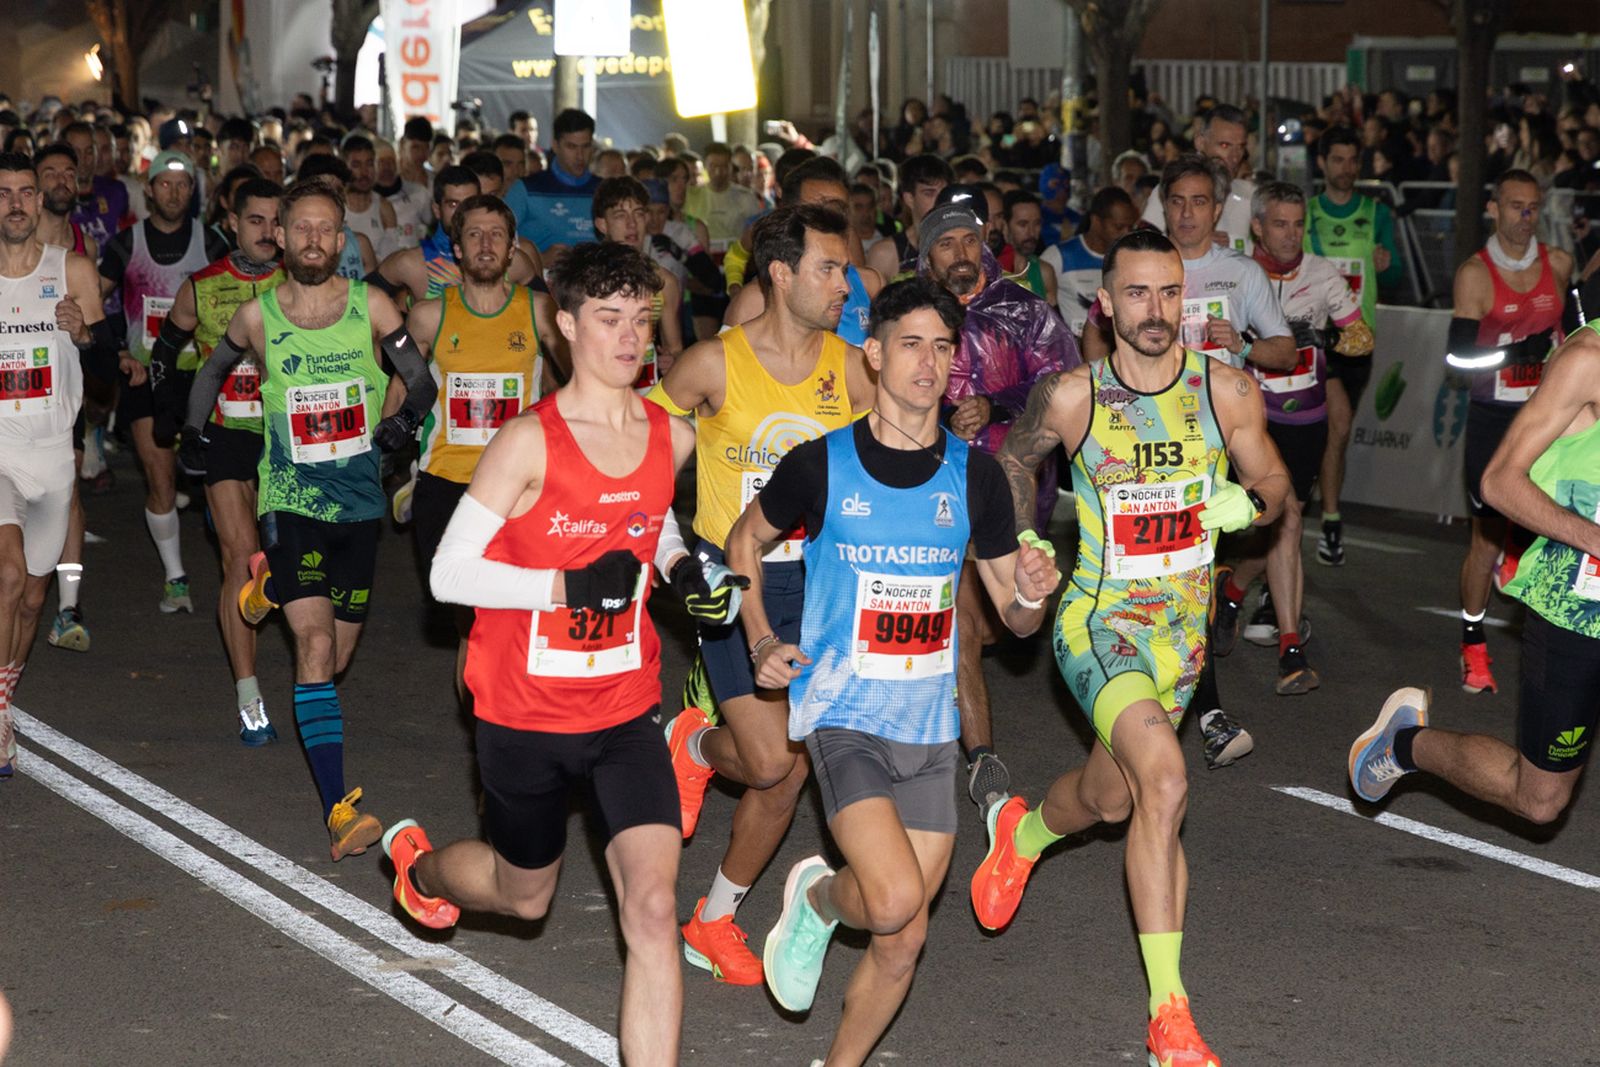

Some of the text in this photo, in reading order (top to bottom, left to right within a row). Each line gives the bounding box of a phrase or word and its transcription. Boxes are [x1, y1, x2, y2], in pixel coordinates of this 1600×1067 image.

[0, 320, 54, 334] Ernesto
[306, 349, 363, 364] Fundación
[307, 363, 350, 376] Unicaja
[487, 381, 496, 389] DE
[304, 393, 328, 401] NOCHE
[330, 391, 339, 400] DE
[454, 390, 470, 398] SAN
[296, 400, 341, 413] SAN ANTÓN
[464, 400, 507, 421] 127
[304, 408, 355, 437] 9410
[1133, 441, 1184, 468] 1153
[1131, 489, 1176, 501] NOCHE DE
[1120, 500, 1177, 513] SAN ANTÓN
[1133, 511, 1193, 545] 2772
[836, 543, 959, 564] TROTASIERRA
[884, 588, 932, 598] NOCHE DE
[869, 598, 931, 612] SAN ANTÓN
[569, 608, 615, 641] 321
[875, 613, 945, 645] 9949
